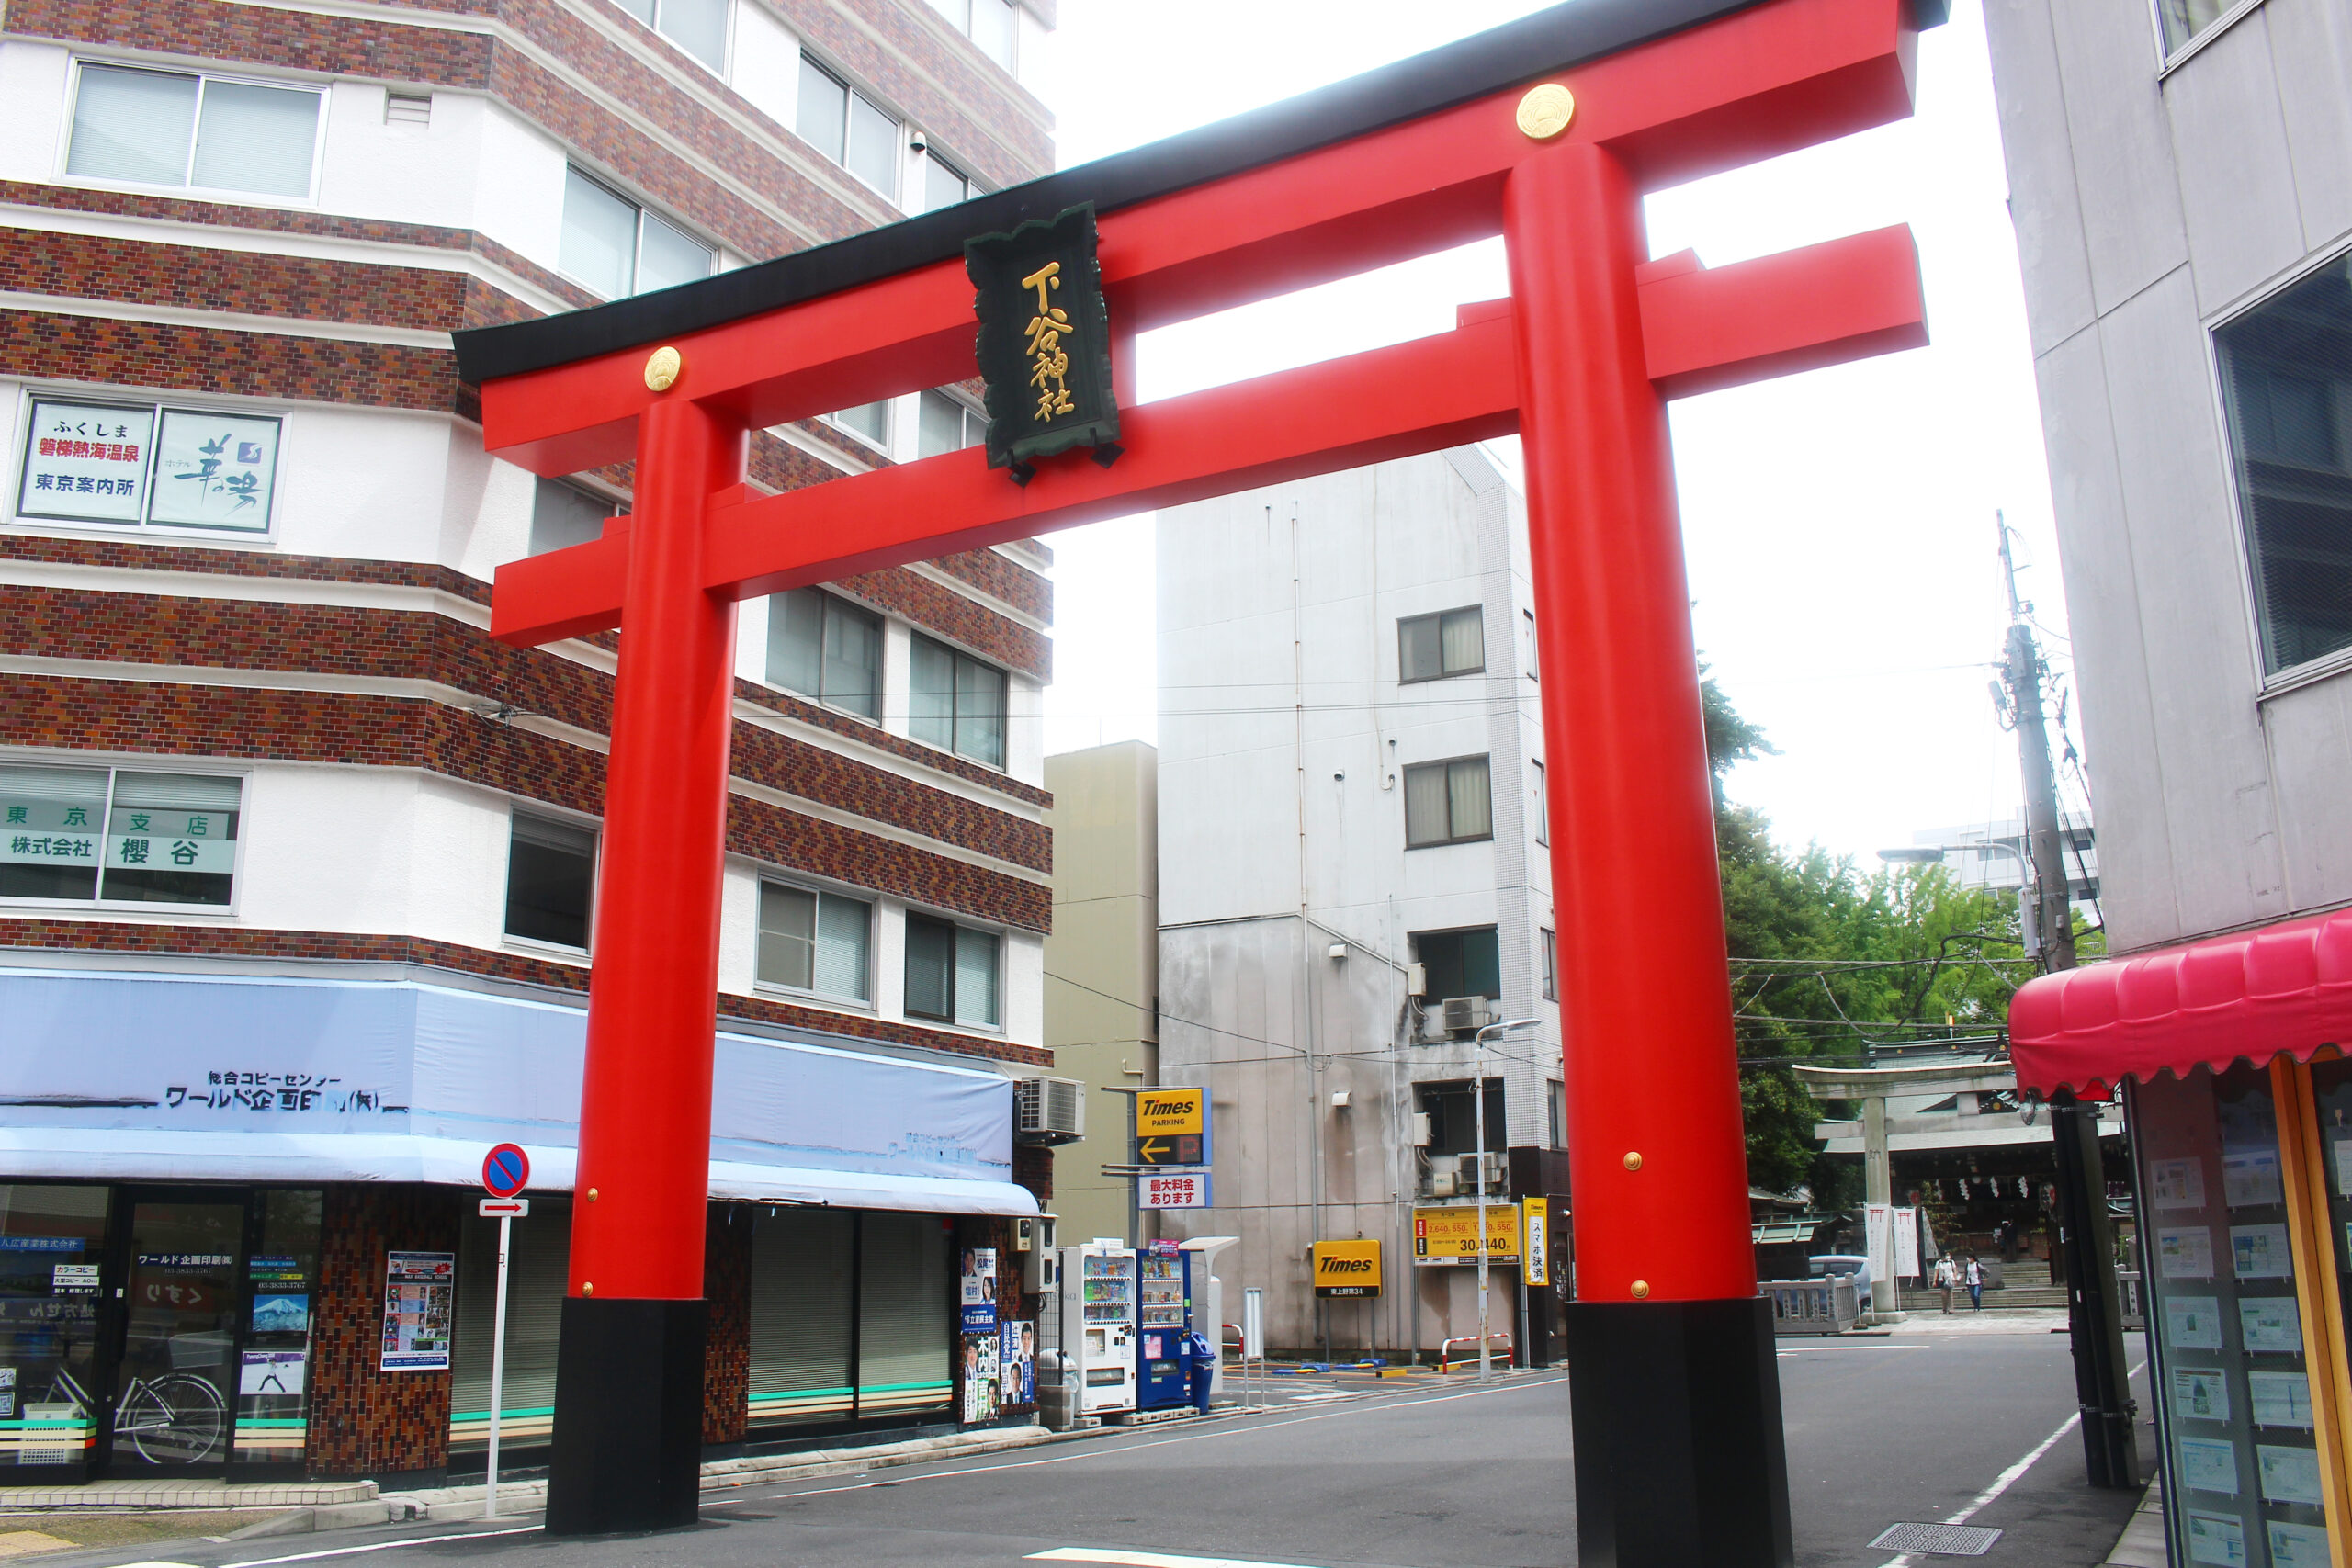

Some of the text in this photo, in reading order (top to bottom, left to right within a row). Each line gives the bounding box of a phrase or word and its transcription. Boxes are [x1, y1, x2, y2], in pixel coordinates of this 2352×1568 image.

[1022, 261, 1075, 423] 下谷神社
[53, 420, 129, 439] ふくしま
[39, 437, 140, 463] 磐梯熱海温泉
[35, 473, 135, 497] 東京案内所
[6, 806, 209, 836] 東京支店
[11, 836, 198, 865] 株式会社 櫻谷
[1143, 1100, 1194, 1116] Times
[1152, 1118, 1185, 1127] PARKING
[1150, 1179, 1194, 1192] 最大料金
[1150, 1192, 1194, 1205] あります
[1532, 1222, 1543, 1278] スマホ決済
[1320, 1256, 1373, 1272] Times
